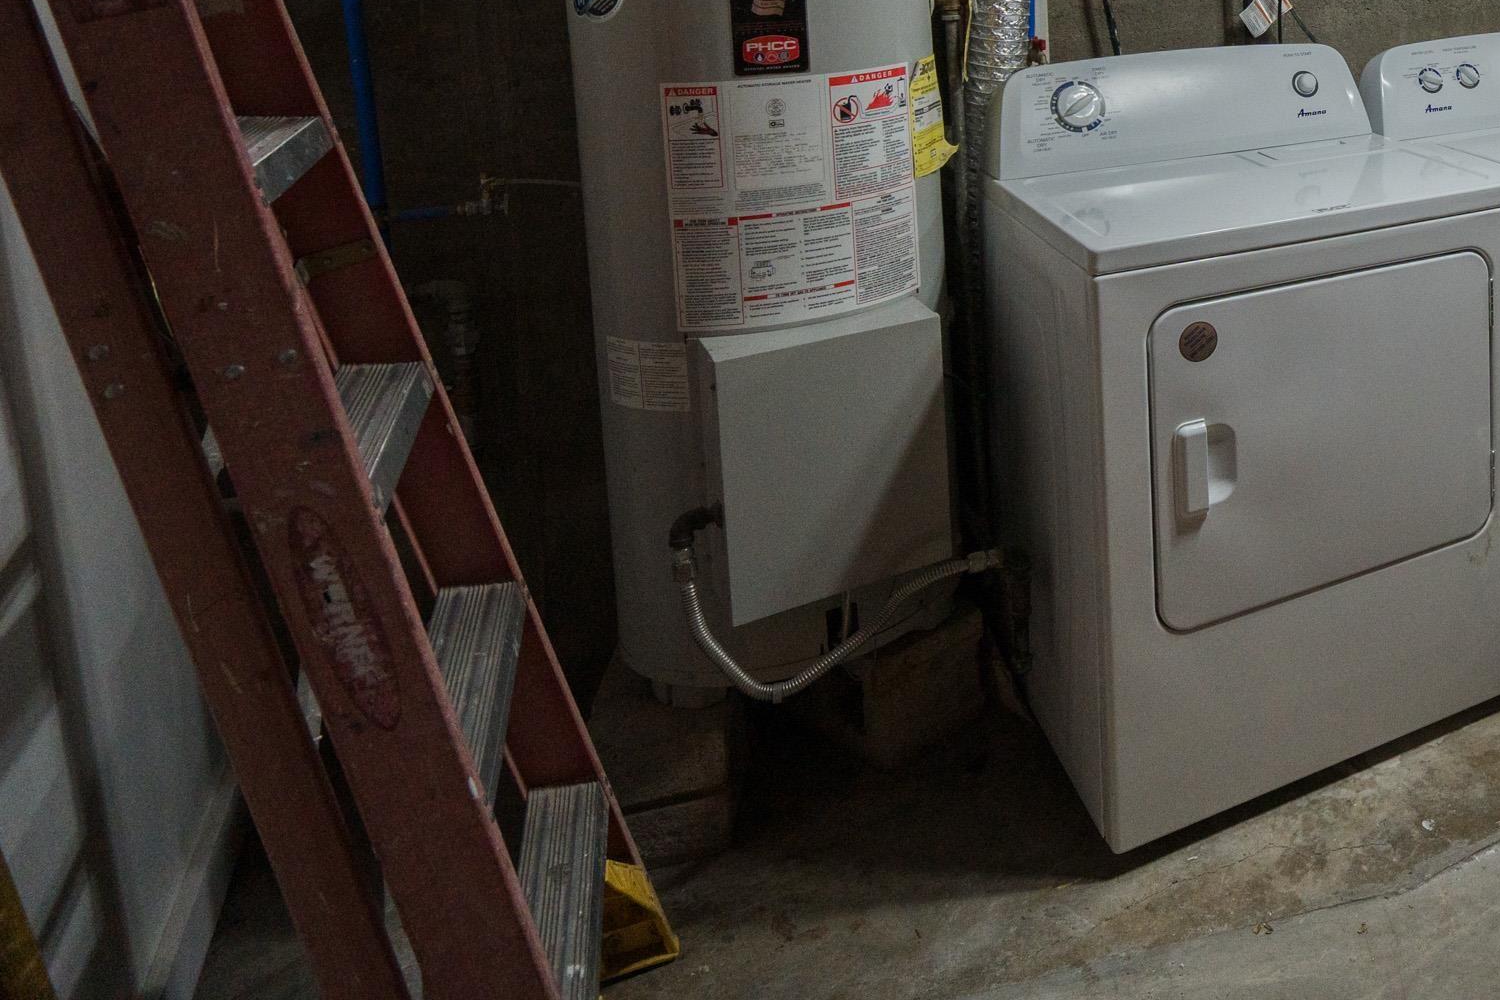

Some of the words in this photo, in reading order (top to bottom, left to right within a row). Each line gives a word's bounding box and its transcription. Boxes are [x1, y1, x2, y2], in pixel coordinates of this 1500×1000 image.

[746, 40, 798, 52] PHCC
[858, 70, 893, 82] DANGER
[677, 87, 714, 96] DANGER
[1297, 108, 1327, 118] Amana
[1425, 104, 1453, 114] Amana
